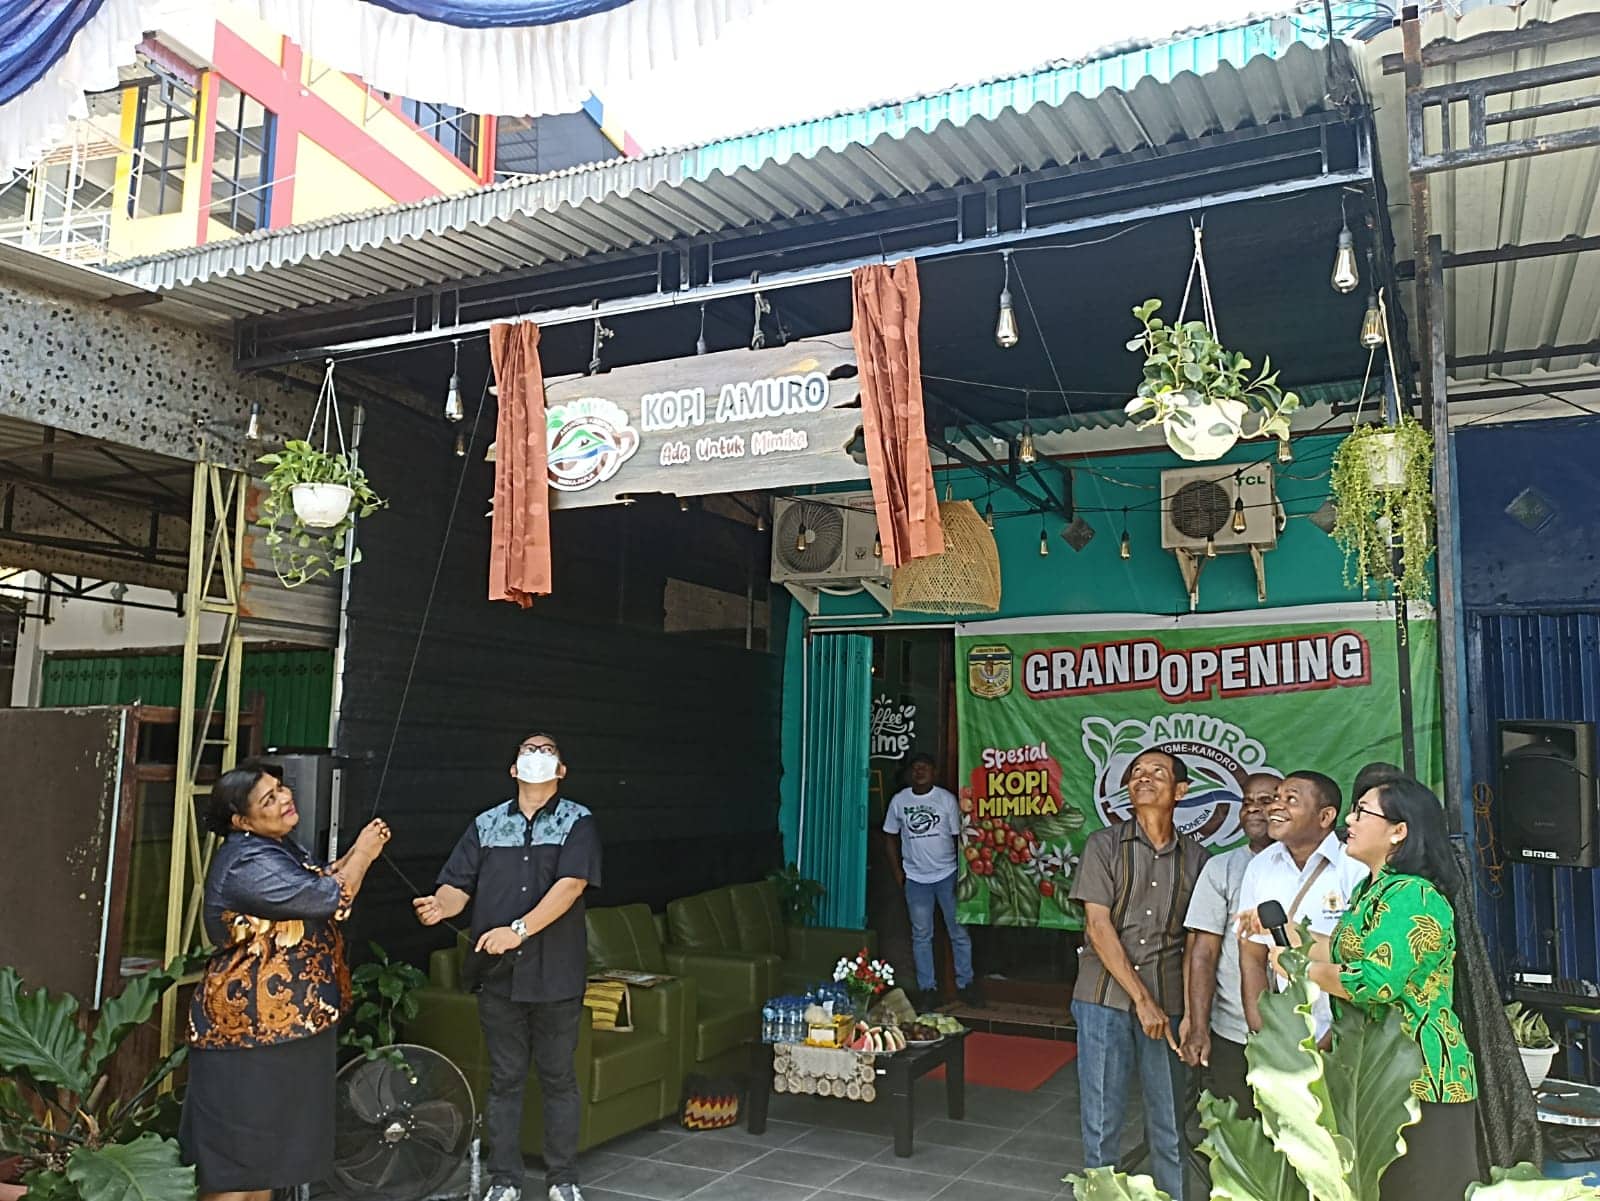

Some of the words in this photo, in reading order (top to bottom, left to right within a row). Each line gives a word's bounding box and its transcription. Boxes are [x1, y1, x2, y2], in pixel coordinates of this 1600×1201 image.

[644, 391, 703, 428] KOPI
[718, 376, 826, 419] AMURO
[661, 443, 690, 463] Ada
[697, 435, 743, 460] Untuk
[752, 428, 808, 454] Mimika
[1235, 475, 1266, 487] TCL
[1025, 641, 1159, 693] GRAND
[1159, 633, 1364, 698] OPENING
[870, 703, 904, 736] ffee
[871, 734, 910, 754] ime
[981, 741, 1049, 769] Spesial
[1152, 718, 1261, 766] AMURO
[1160, 743, 1238, 772] GME-KAMORO
[987, 770, 1048, 797] KOPI
[977, 795, 1059, 818] MIMIKA
[1177, 809, 1212, 833] DONESIA
